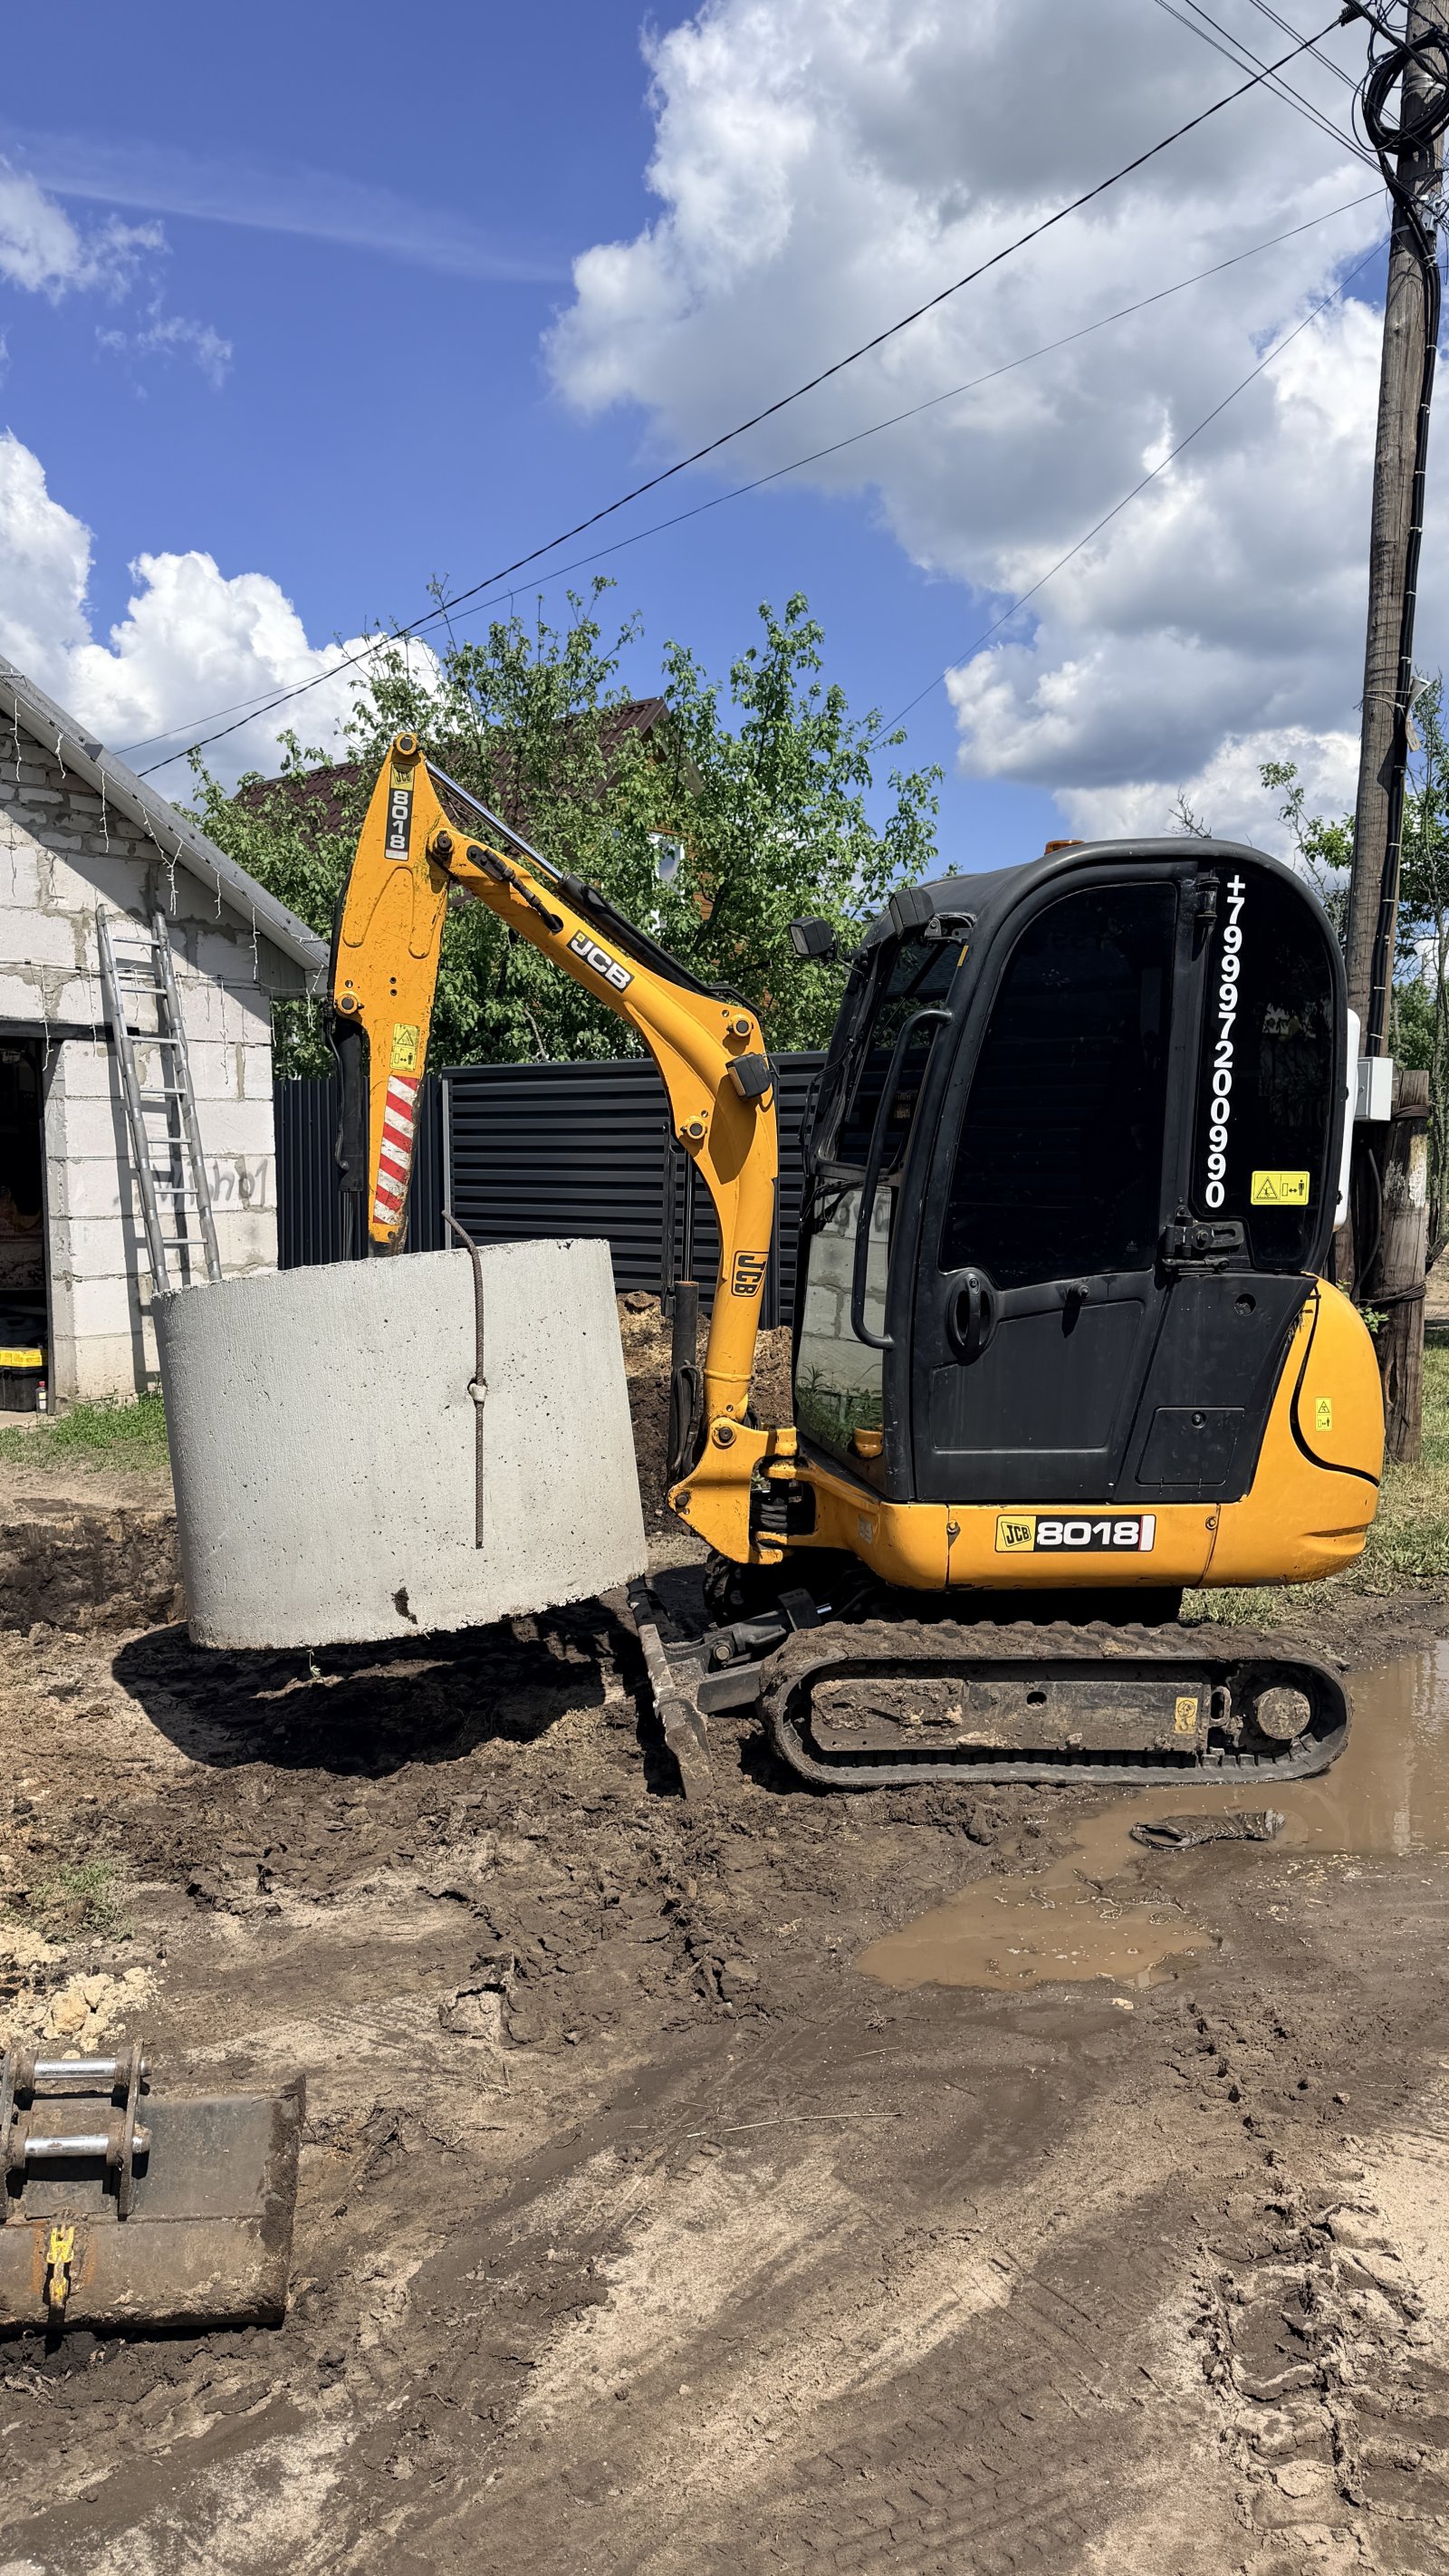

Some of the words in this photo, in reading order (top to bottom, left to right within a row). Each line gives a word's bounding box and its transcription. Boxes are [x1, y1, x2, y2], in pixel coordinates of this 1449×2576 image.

[389, 790, 408, 850] 8018
[571, 934, 631, 989] JCB
[1205, 875, 1245, 1207] +79997200990
[734, 1254, 767, 1294] JCB
[1005, 1523, 1030, 1545] JCB
[1037, 1522, 1140, 1545] 8018
